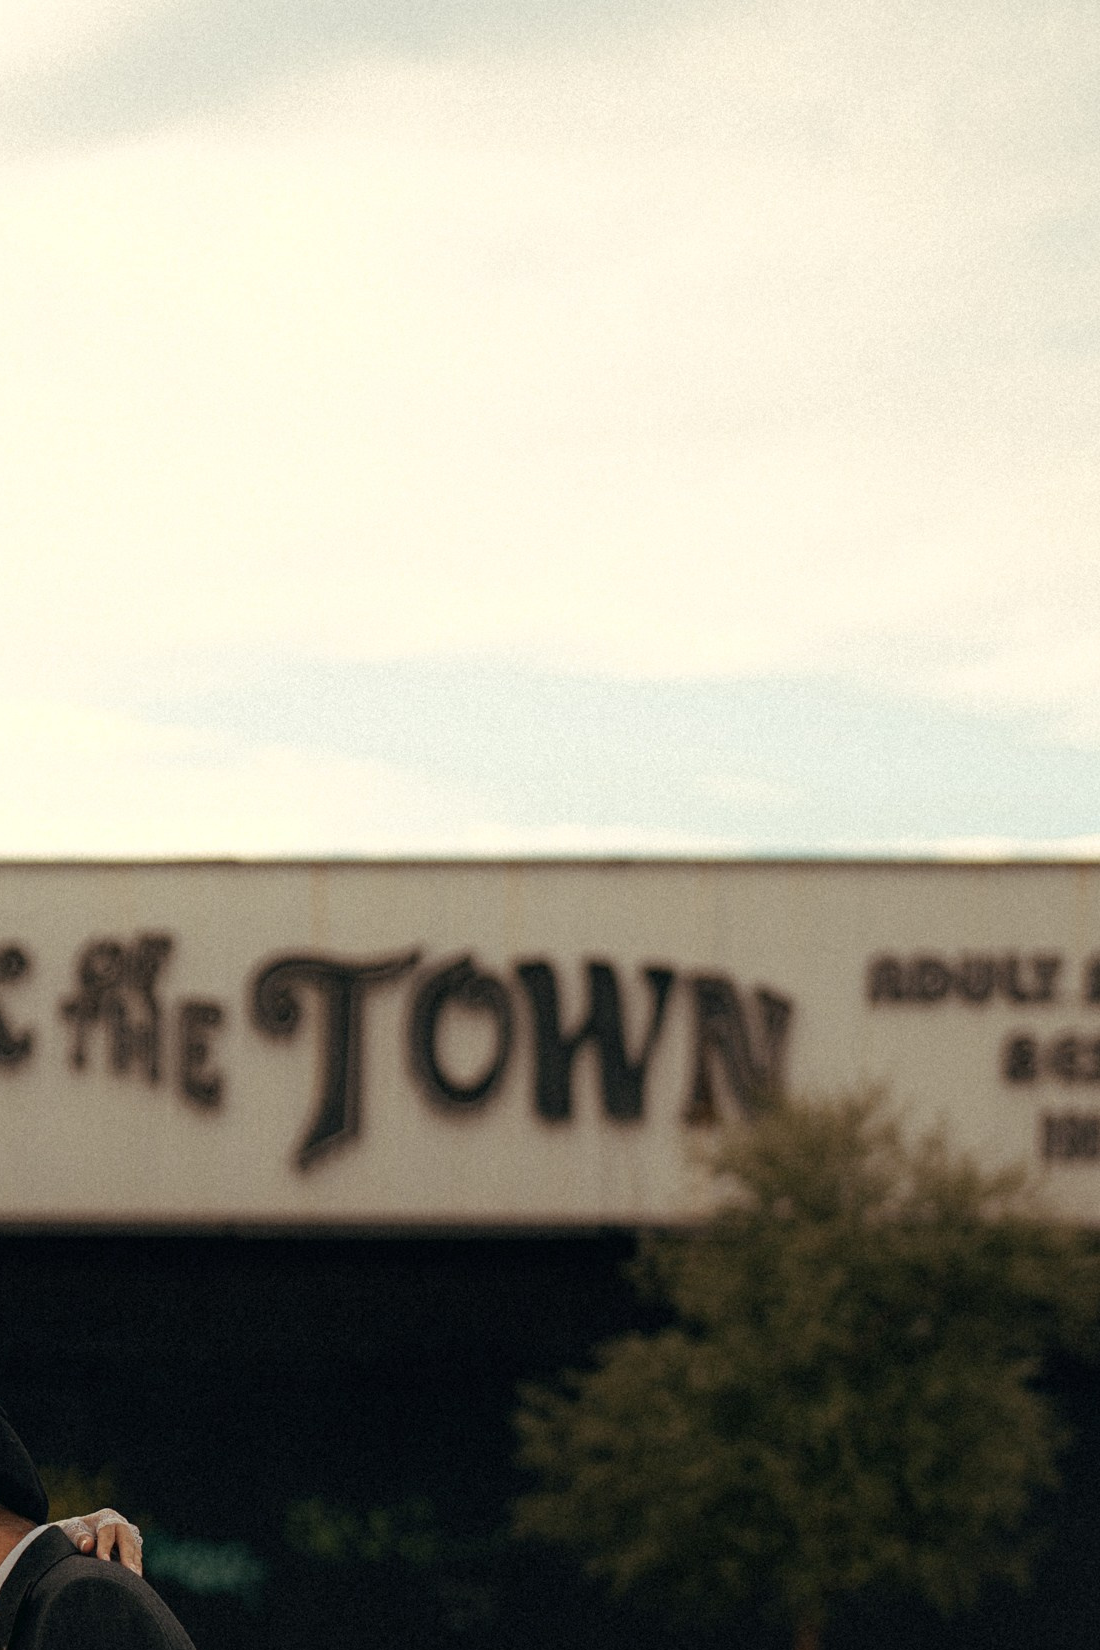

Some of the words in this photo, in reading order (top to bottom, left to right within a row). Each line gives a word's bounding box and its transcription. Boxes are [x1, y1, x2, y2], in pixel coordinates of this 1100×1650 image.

[866, 953, 1062, 1005] ADULT
[59, 997, 225, 1112] THE
[251, 950, 791, 1170] TOWN
